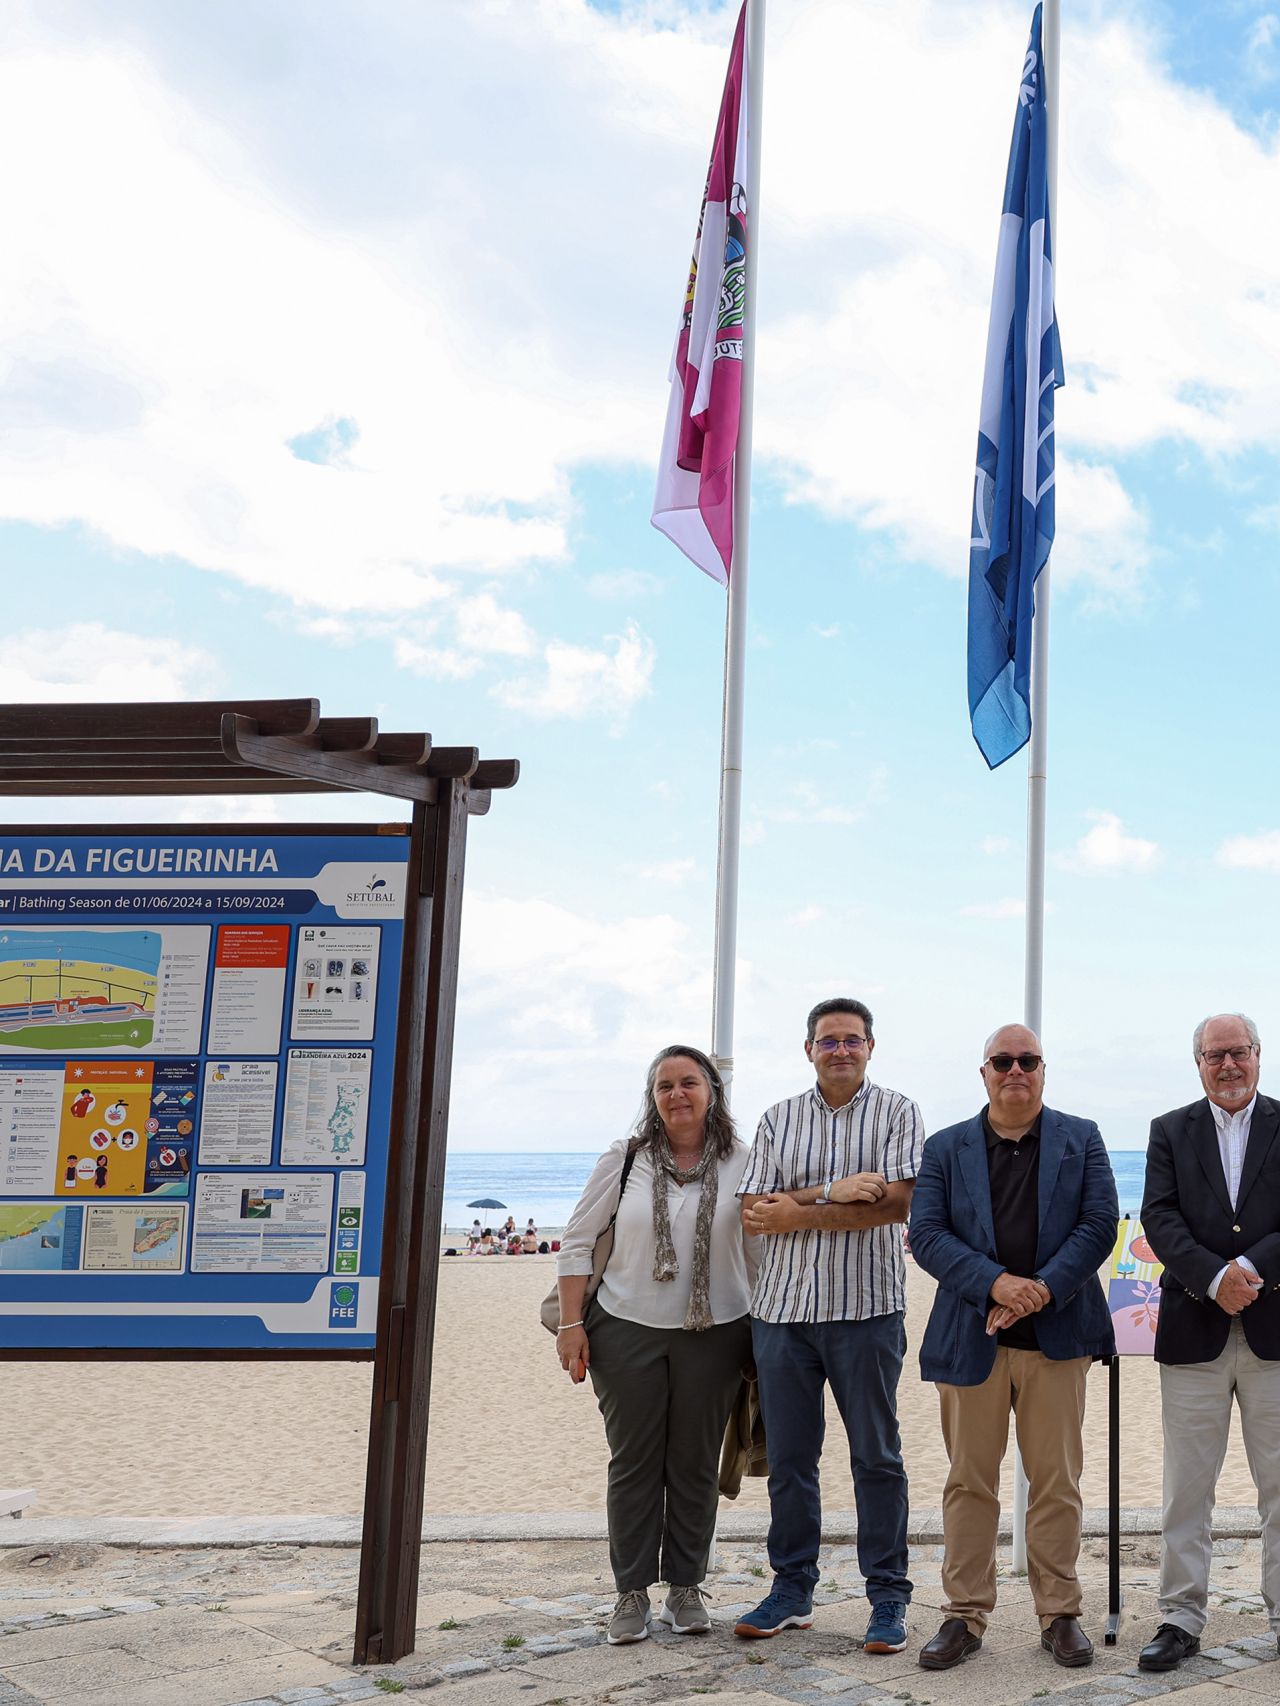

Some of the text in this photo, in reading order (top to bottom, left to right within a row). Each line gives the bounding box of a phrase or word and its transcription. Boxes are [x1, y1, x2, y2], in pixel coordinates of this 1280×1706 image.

[34, 849, 76, 872] DA
[86, 848, 279, 872] FIGUEIRINHA
[20, 896, 66, 910] Bathing
[69, 896, 111, 908] Season
[115, 896, 130, 908] de
[133, 896, 202, 909] 01/06/2024
[205, 899, 212, 908] a
[216, 896, 285, 909] 15/09/2024
[332, 1308, 355, 1318] FEE
